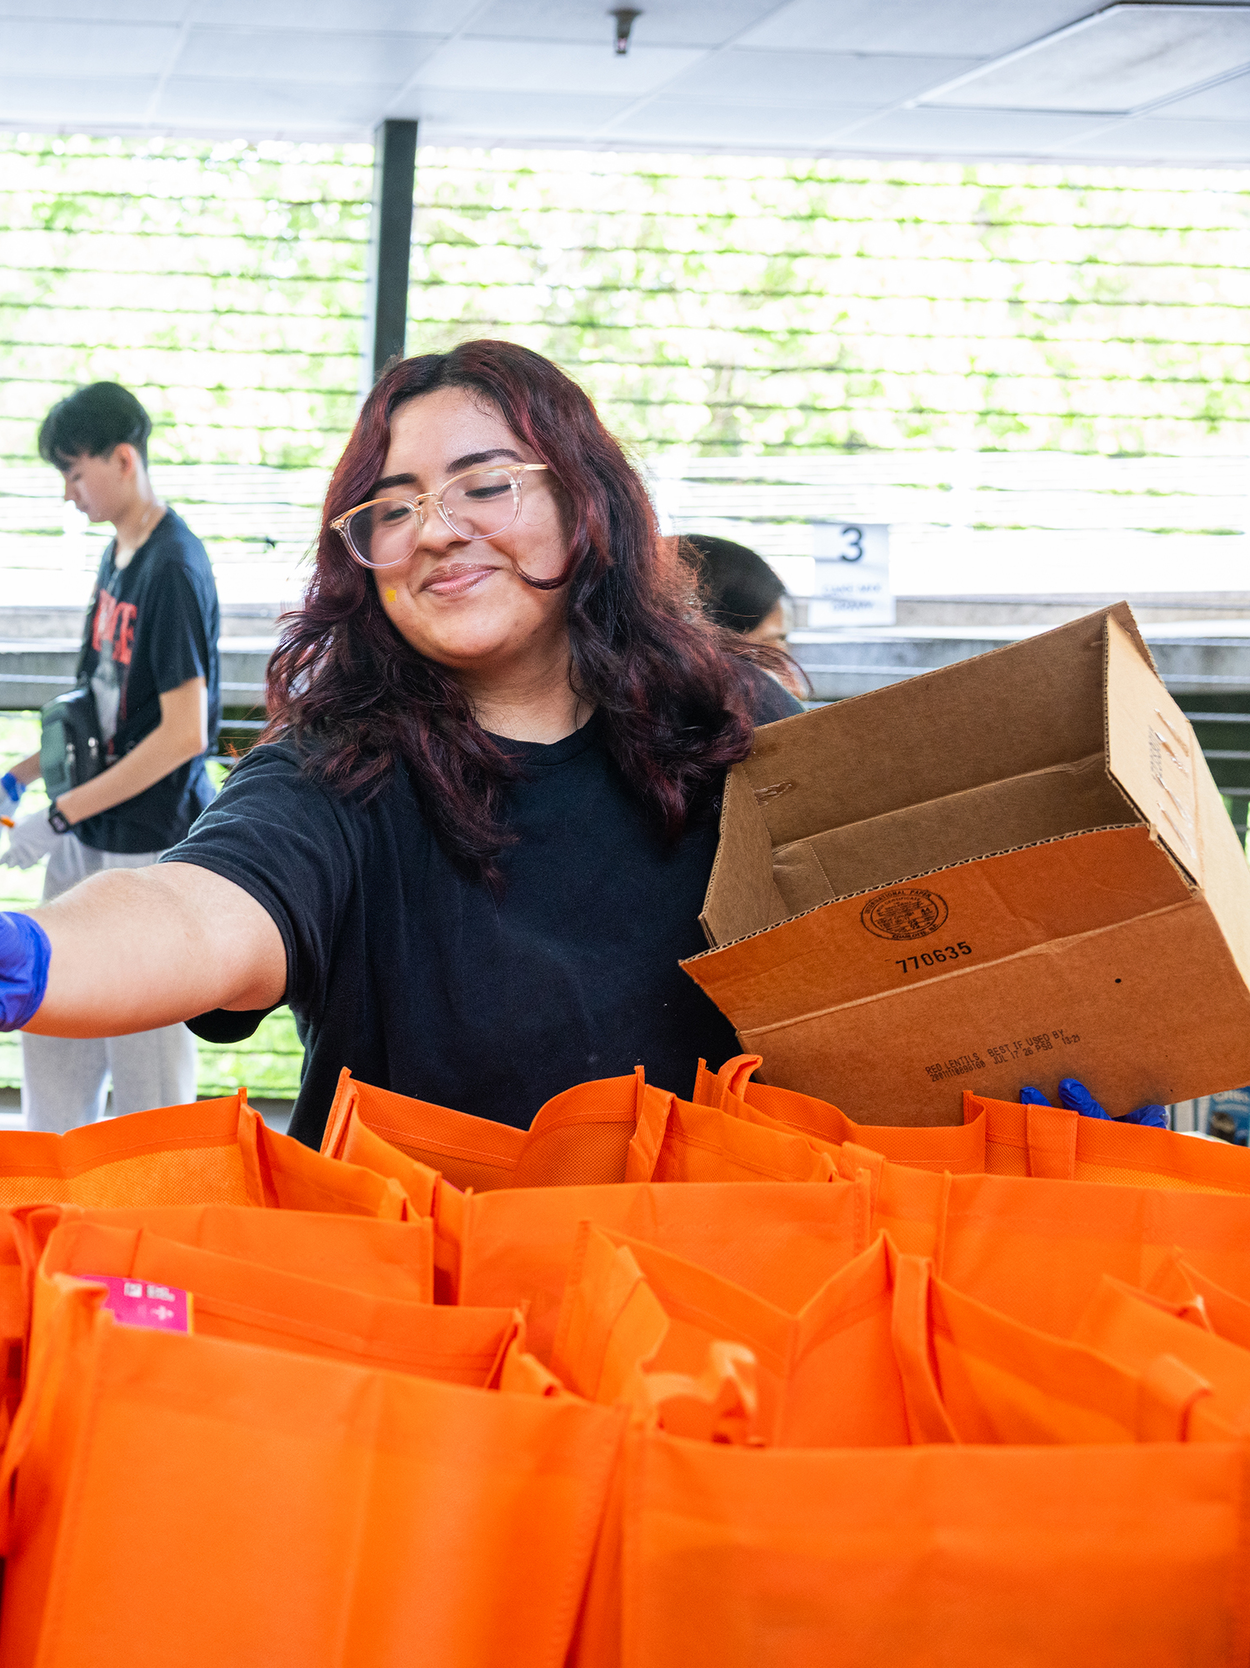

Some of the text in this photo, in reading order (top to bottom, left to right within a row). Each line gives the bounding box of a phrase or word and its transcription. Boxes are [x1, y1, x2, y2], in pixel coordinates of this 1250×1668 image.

[841, 526, 864, 563] 3
[895, 941, 973, 974] 770635
[925, 1029, 1064, 1075] RED LENTILS BEST IF USED BY
[993, 1055, 1008, 1065] JUL
[1010, 1050, 1020, 1060] 17
[1022, 1046, 1034, 1056] 26
